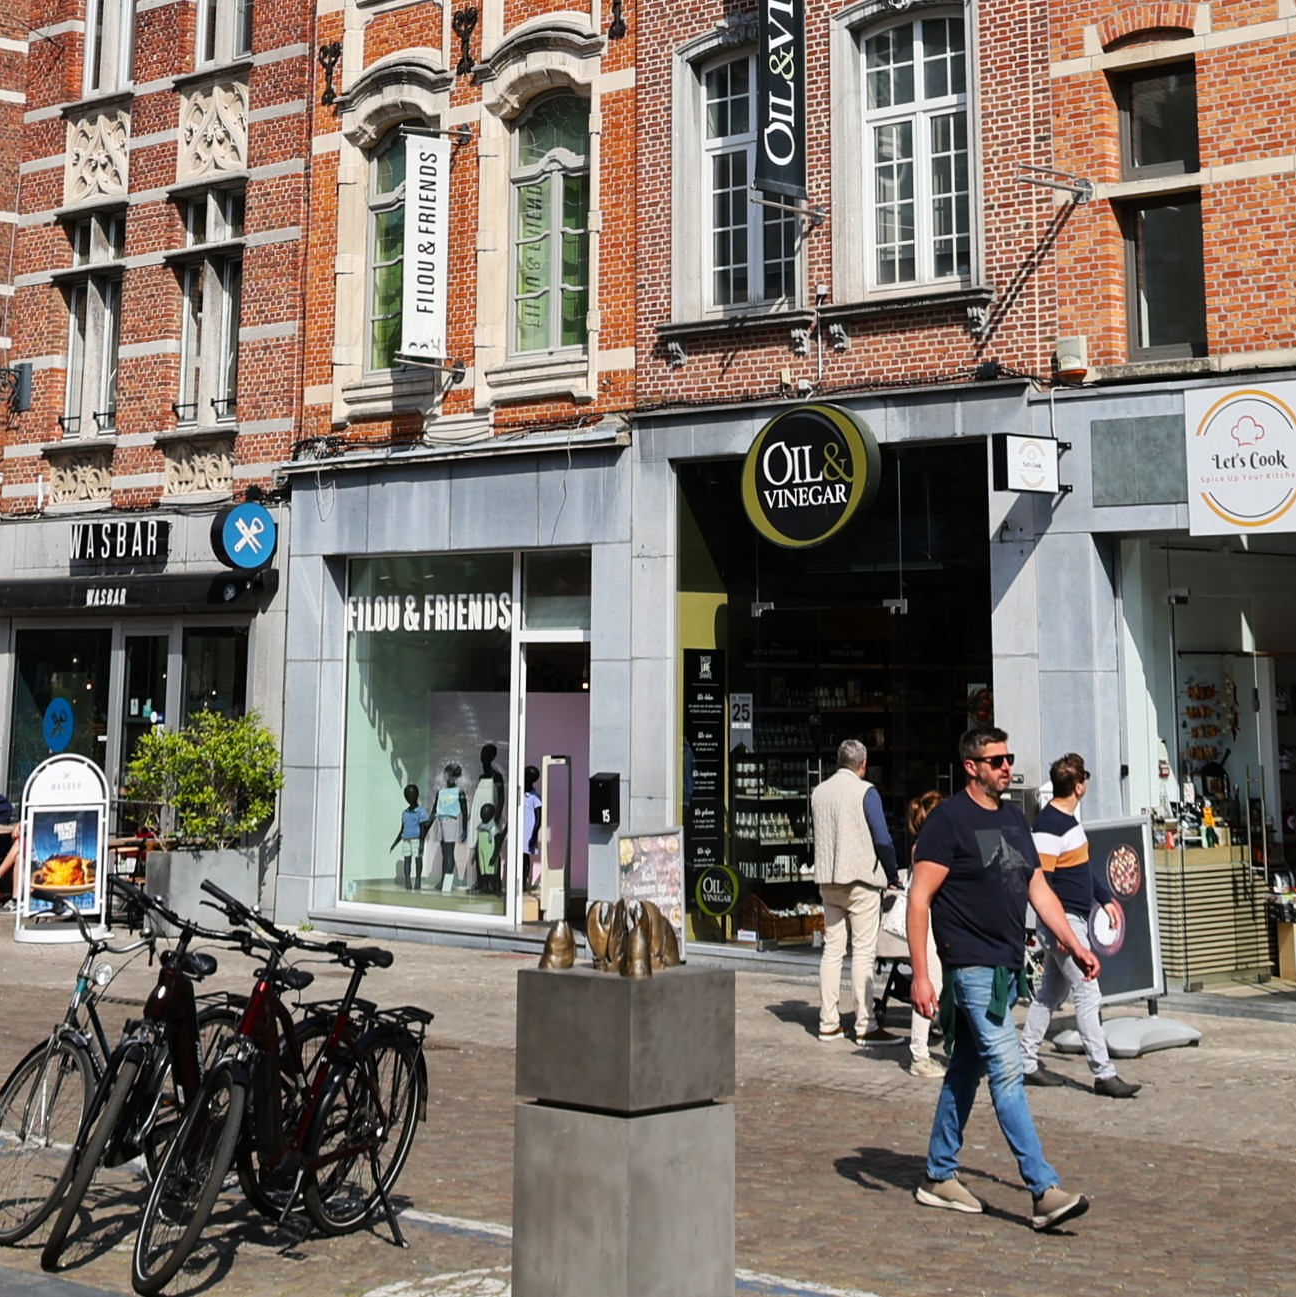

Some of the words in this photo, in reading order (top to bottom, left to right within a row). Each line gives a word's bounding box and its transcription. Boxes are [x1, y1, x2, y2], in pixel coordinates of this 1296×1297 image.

[418, 151, 438, 235] FRIENDS
[417, 241, 436, 256] &
[416, 262, 436, 314] FILOU
[1212, 453, 1246, 470] Let's
[1250, 449, 1289, 470] Cook
[1200, 476, 1225, 484] Spice
[1243, 473, 1263, 481] Your
[764, 484, 848, 509] VINEGAR
[69, 520, 158, 559] WASBAR
[86, 588, 127, 607] WASBAR
[347, 595, 401, 633] FILOU
[403, 594, 420, 632] &
[423, 592, 513, 632] FRIENDS
[732, 704, 750, 722] 25
[602, 809, 611, 823] 15
[702, 893, 732, 903] VINEGAR
